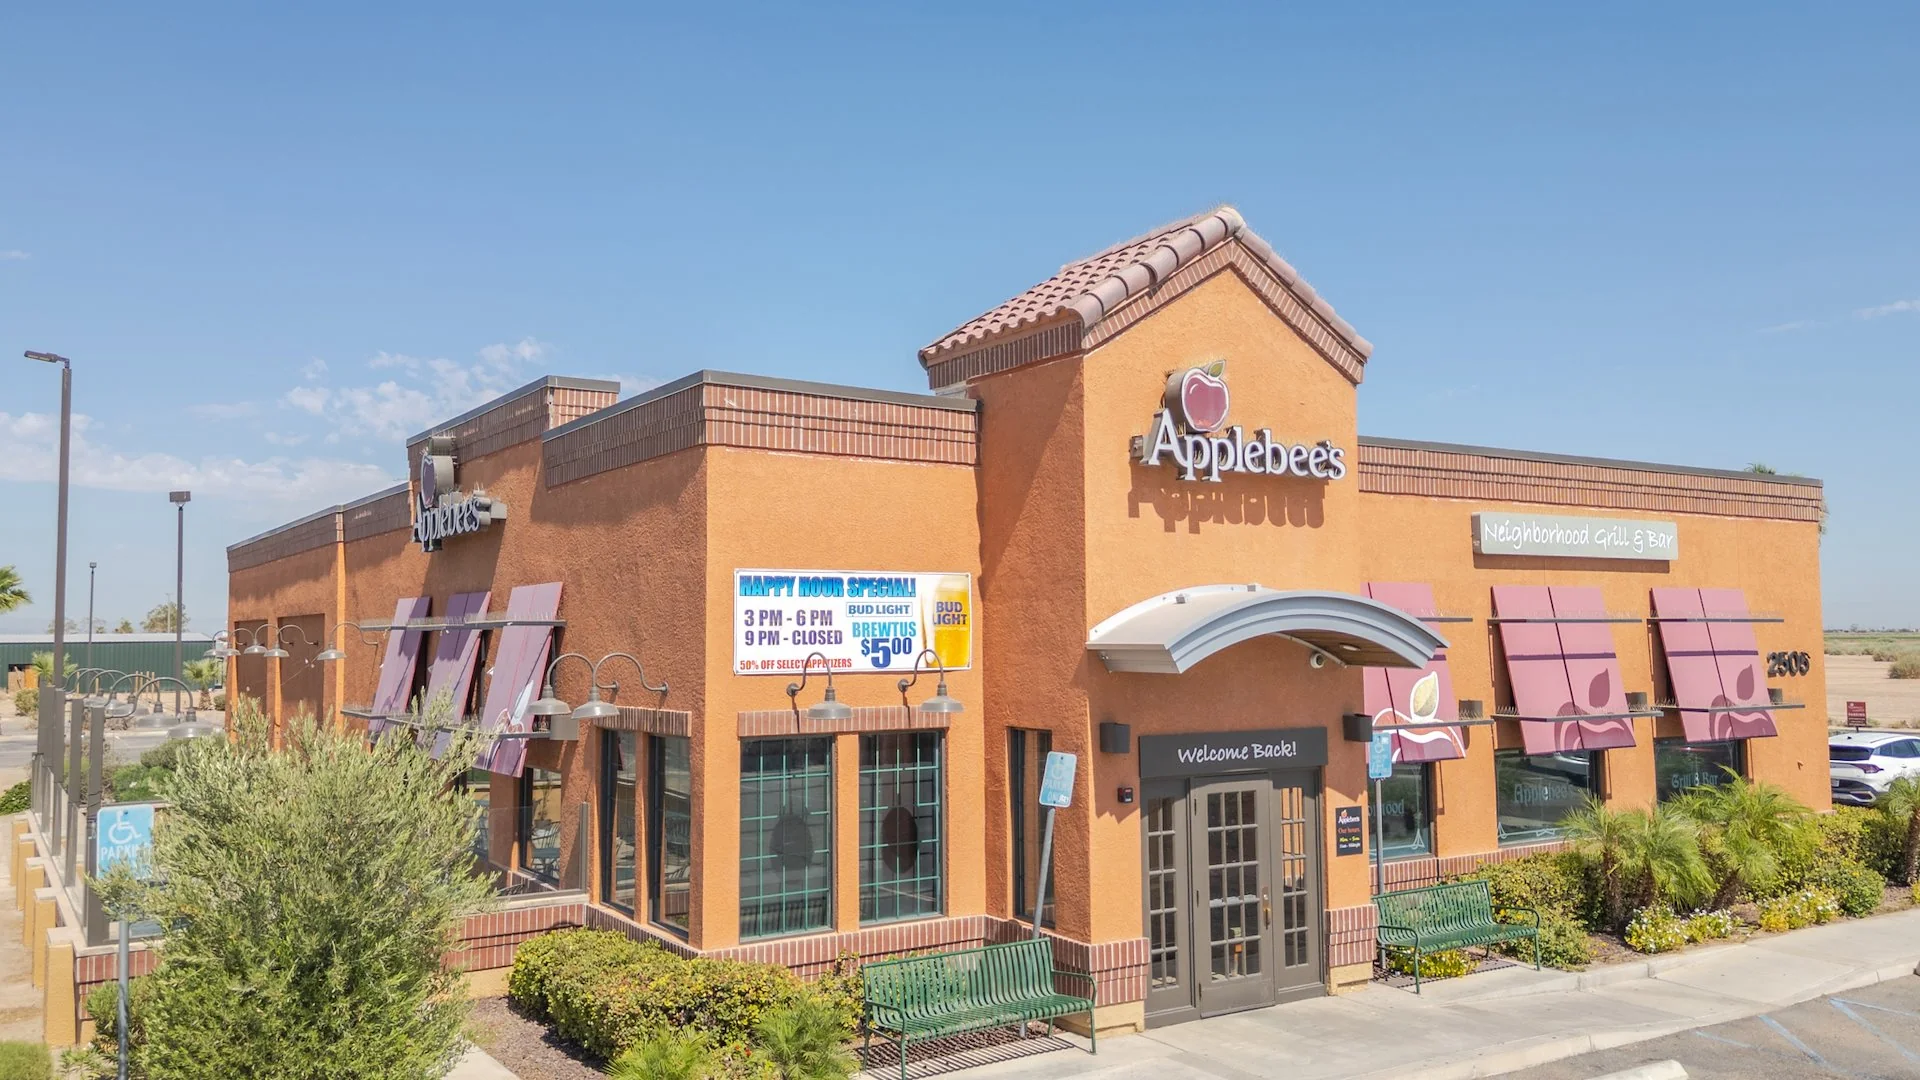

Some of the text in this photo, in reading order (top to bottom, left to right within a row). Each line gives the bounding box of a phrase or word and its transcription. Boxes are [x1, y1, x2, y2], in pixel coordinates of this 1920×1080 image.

[1139, 408, 1346, 482] Applebee's
[1484, 520, 1673, 553] Neighborhood Grill & Bar
[739, 575, 917, 598] HAPPY HOUR SPECIAL!
[848, 604, 910, 615] BUD LIGHT
[936, 601, 963, 613] BUD
[744, 609, 755, 627] 3
[758, 609, 783, 627] PM
[796, 609, 806, 627] 6
[810, 609, 833, 627] PM
[744, 630, 755, 646] 9
[758, 630, 780, 646] PM
[791, 629, 843, 646] CLOSED
[852, 621, 917, 638] BREWTUS
[739, 658, 852, 671] 50% OFF SELECT APPETIZERS
[1177, 740, 1297, 764] Welcome Back!
[101, 842, 151, 861] PARKI
